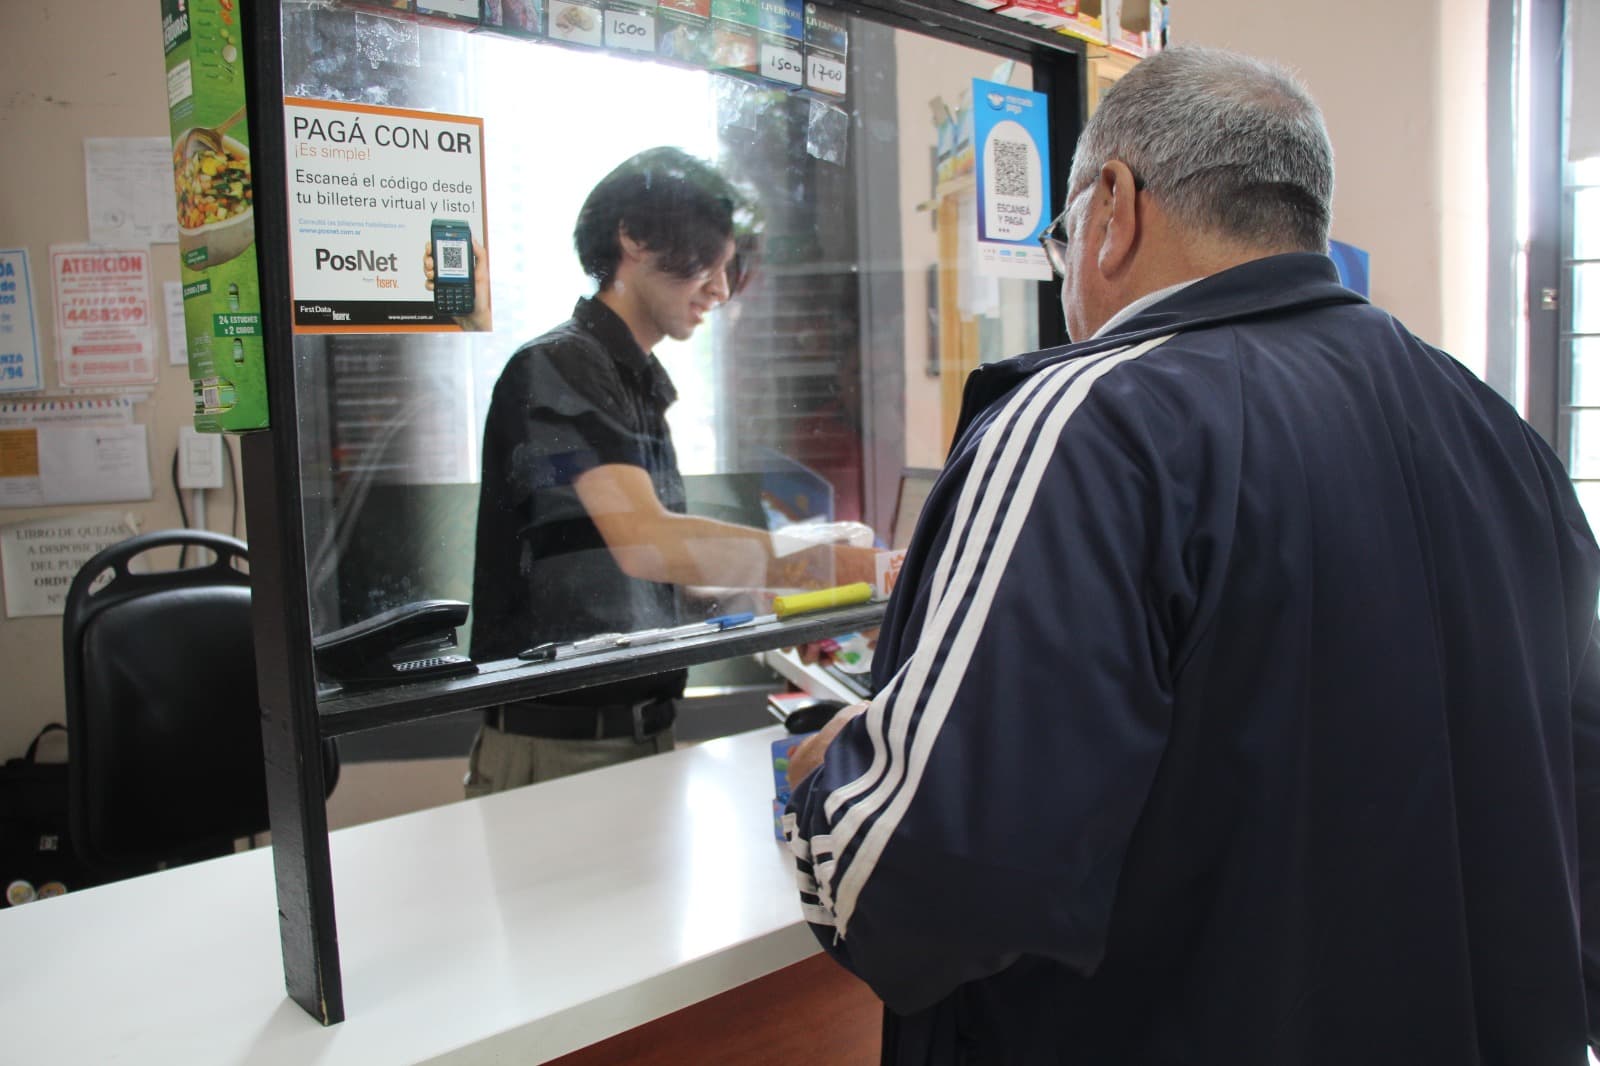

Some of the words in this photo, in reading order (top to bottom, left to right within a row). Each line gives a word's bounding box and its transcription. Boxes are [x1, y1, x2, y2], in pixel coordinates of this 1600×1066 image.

[613, 19, 647, 36] 1500
[771, 56, 801, 72] 1500
[812, 63, 842, 82] 1700
[294, 116, 367, 145] PAGÁ
[375, 125, 429, 151] CON
[438, 131, 472, 154] QR
[295, 142, 317, 159] ¡Es
[320, 147, 371, 162] simple!
[296, 169, 358, 187] Escaneá
[363, 174, 376, 188] el
[380, 177, 428, 193] código
[432, 180, 473, 194] desde
[297, 191, 311, 204] tu
[317, 192, 377, 209] billetera
[381, 196, 426, 211] virtual
[430, 201, 438, 214] y
[442, 199, 476, 214] listo!
[315, 248, 398, 273] PosNet
[315, 305, 331, 313] Data
[16, 528, 55, 540] LIBRO
[58, 528, 73, 538] DE
[28, 545, 37, 555] A
[31, 560, 55, 571] DEL
